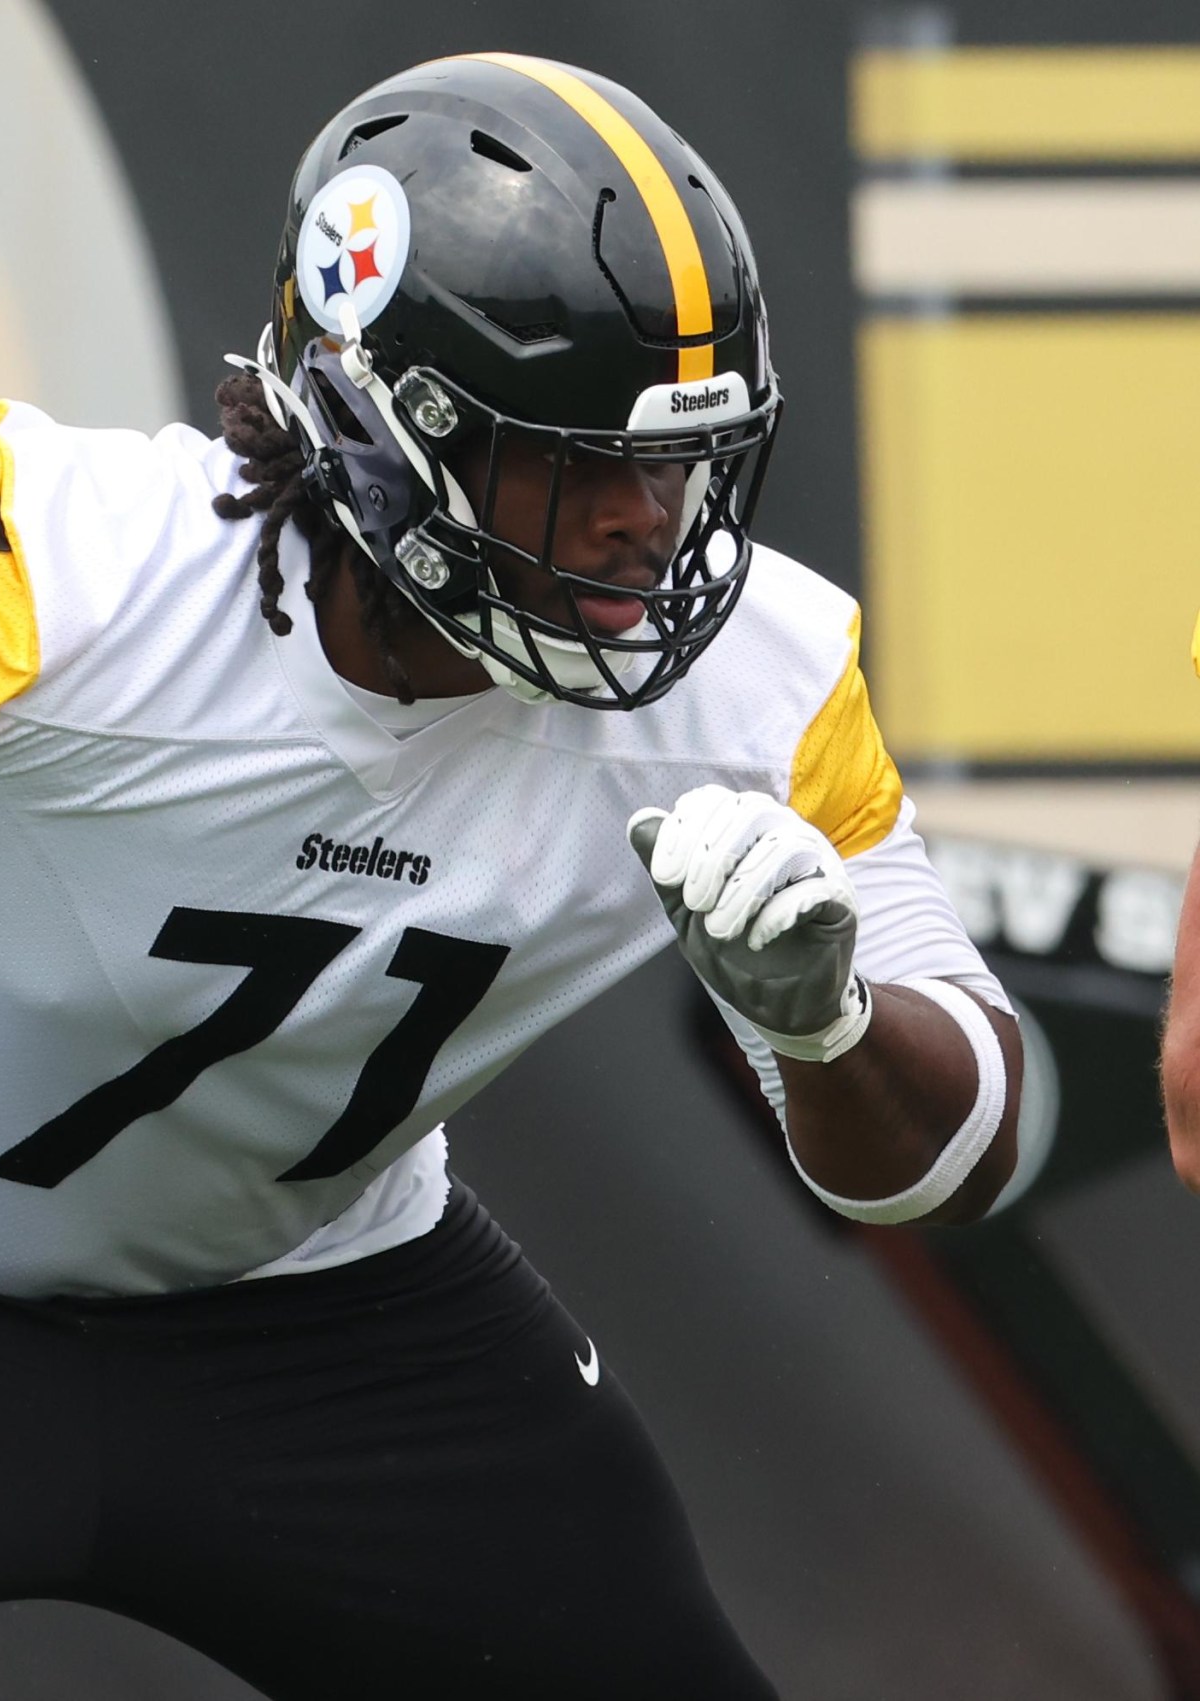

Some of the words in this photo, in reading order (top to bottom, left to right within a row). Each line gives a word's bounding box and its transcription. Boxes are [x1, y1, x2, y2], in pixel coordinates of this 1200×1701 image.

[315, 211, 343, 247] Steelers
[670, 386, 730, 414] Steelers
[296, 833, 431, 885] Steelers
